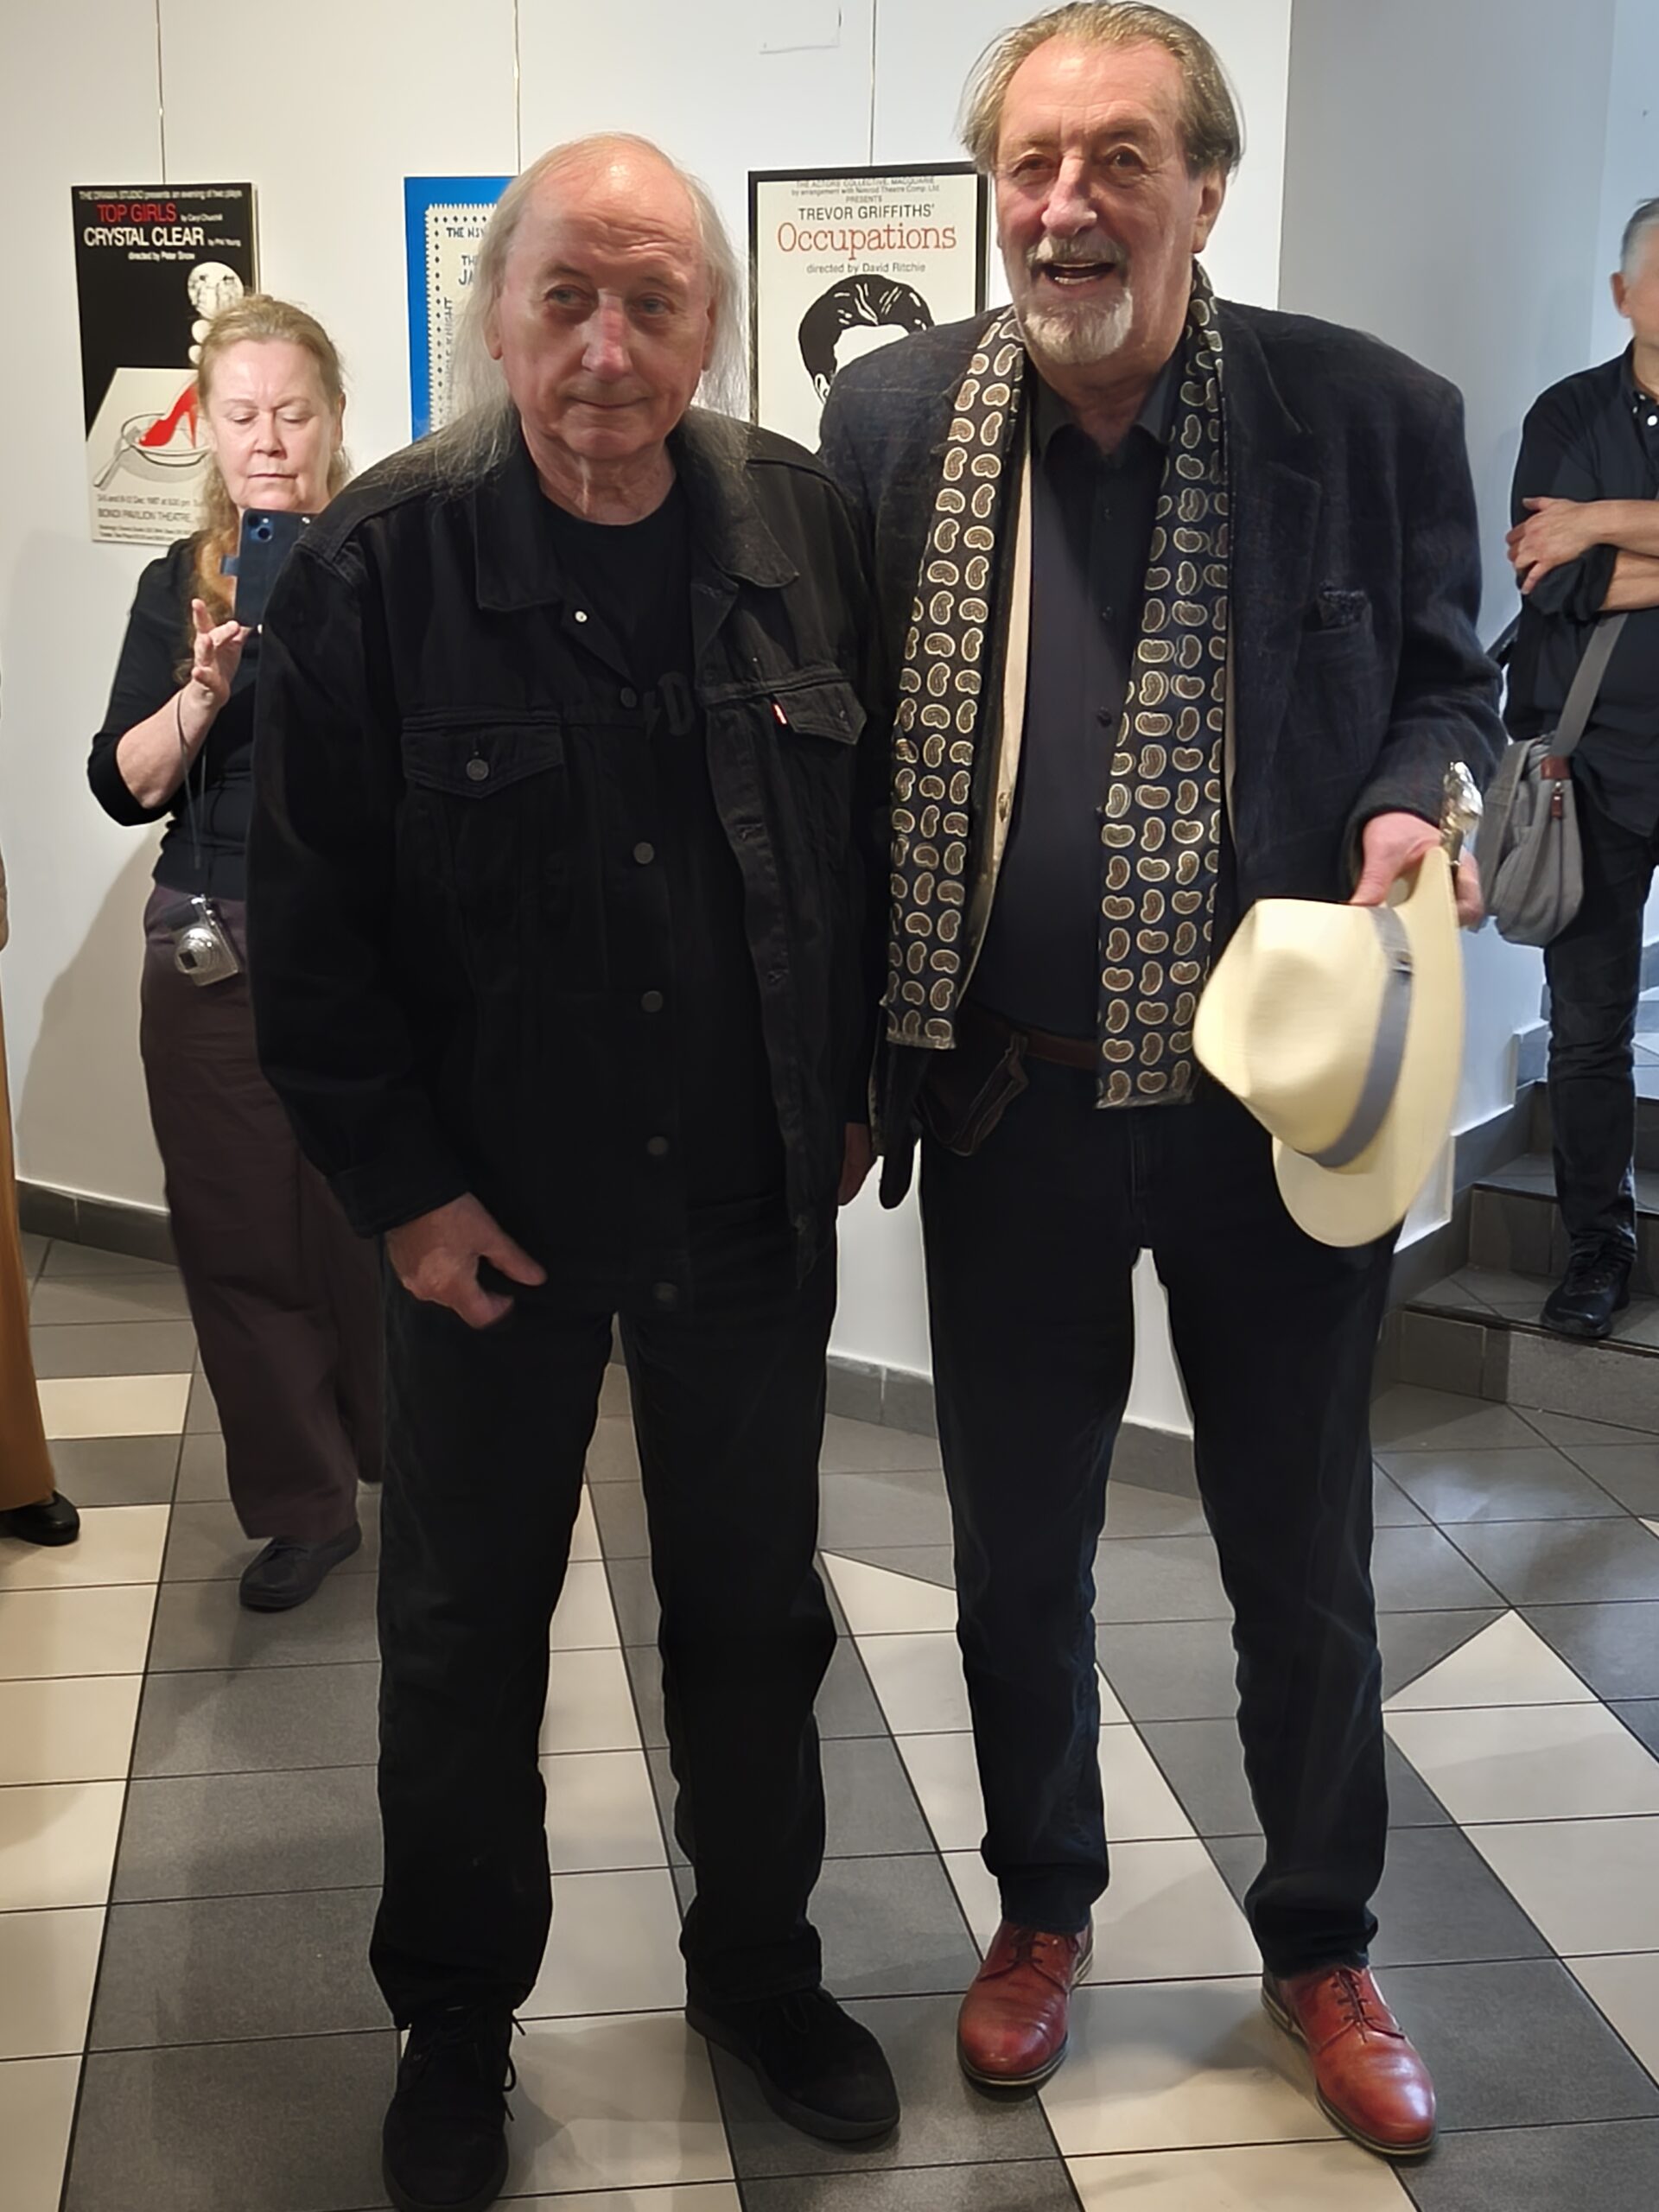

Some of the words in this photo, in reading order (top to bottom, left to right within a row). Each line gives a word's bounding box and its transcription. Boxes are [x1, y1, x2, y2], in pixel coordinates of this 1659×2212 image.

[97, 204, 127, 222] TOP
[130, 203, 176, 222] GIRLS
[798, 207, 853, 220] TREVOR
[84, 227, 149, 246] CRYSTAL
[151, 226, 205, 246] CLEAR
[446, 226, 464, 238] THE
[778, 222, 957, 260] Occupations
[806, 264, 844, 274] directed
[847, 264, 859, 275] by
[862, 263, 889, 272] David
[893, 262, 925, 272] Ritchie
